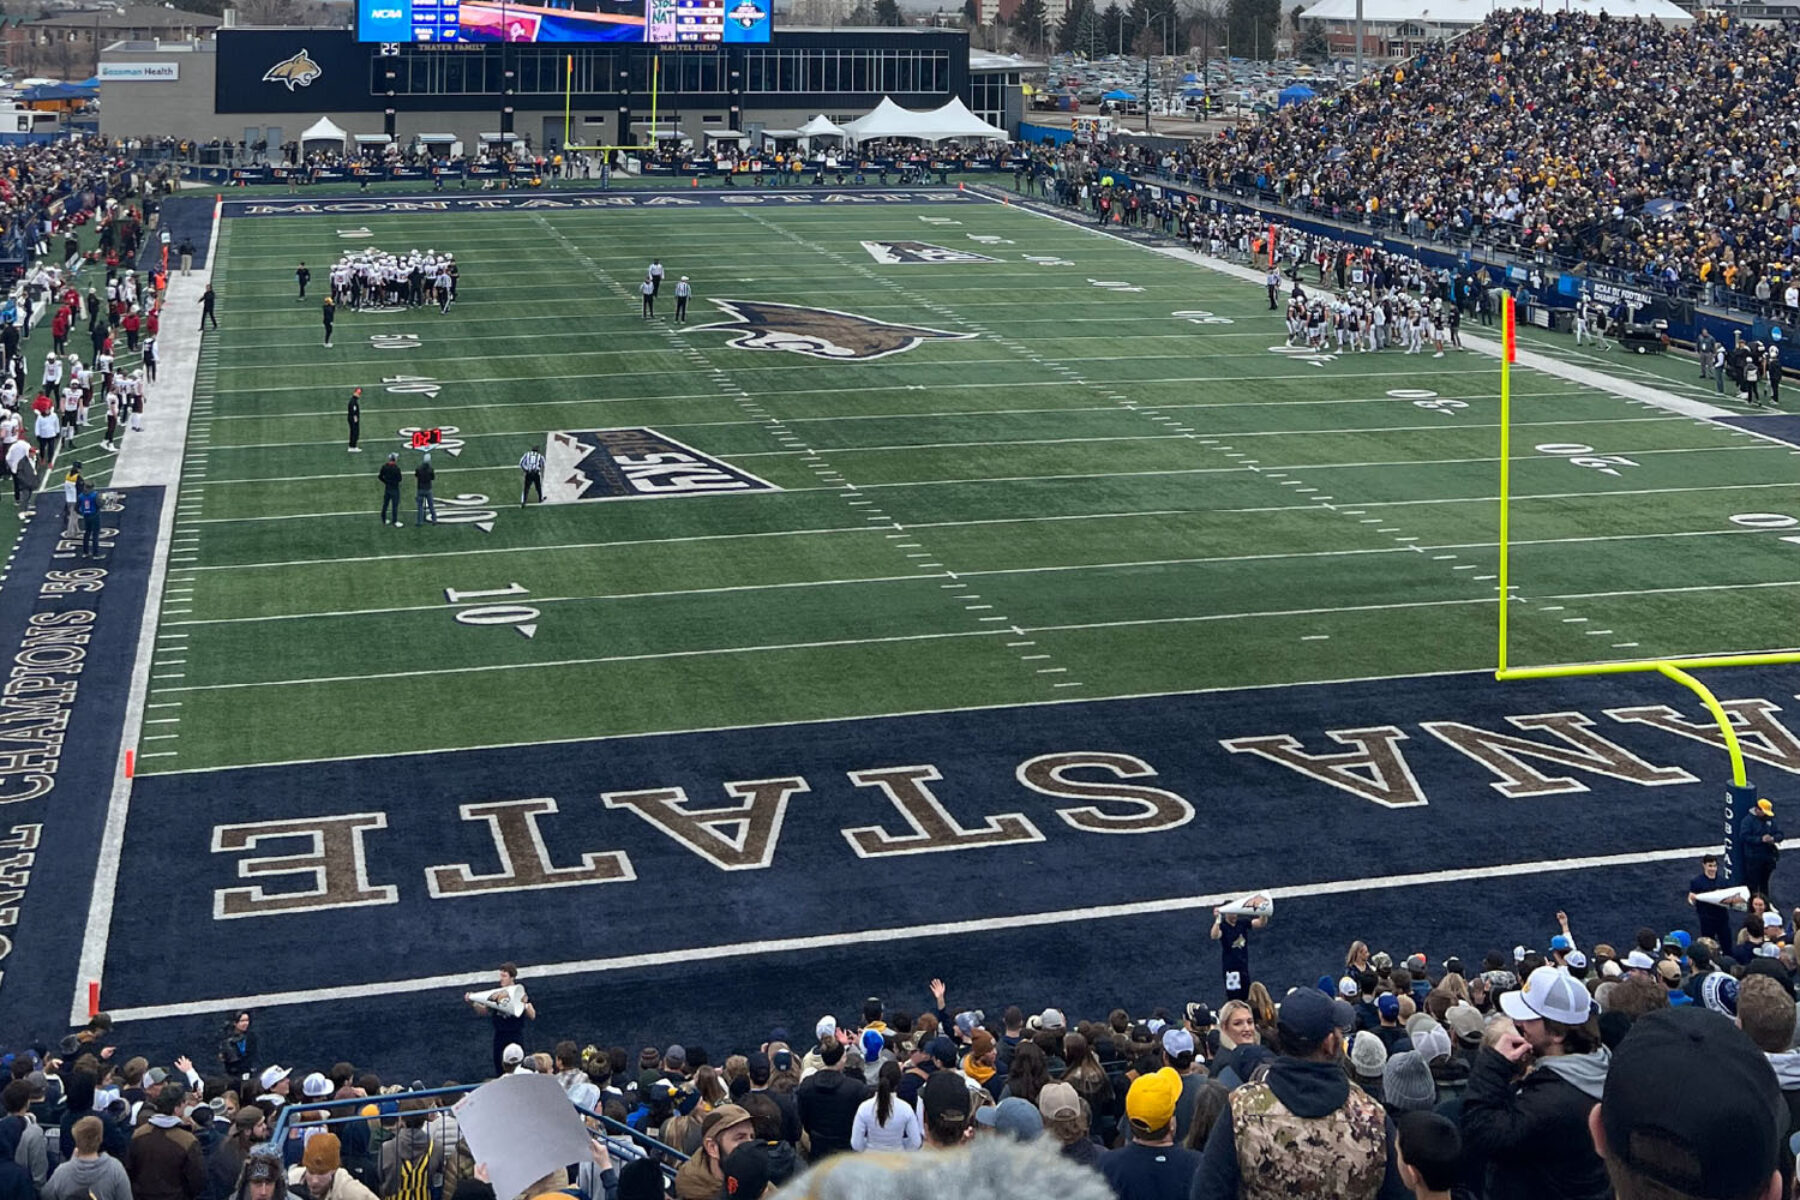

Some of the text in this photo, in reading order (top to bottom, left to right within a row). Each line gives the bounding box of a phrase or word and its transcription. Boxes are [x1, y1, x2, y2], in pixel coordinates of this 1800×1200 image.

[381, 42, 399, 56] 25
[144, 67, 174, 76] Health
[244, 192, 972, 216] MONTANA STATE
[1594, 283, 1611, 294] NCAA
[1621, 289, 1652, 305] FOOTBALL
[613, 452, 751, 493] SKY
[444, 582, 541, 625] 10
[210, 750, 1197, 920] STATE
